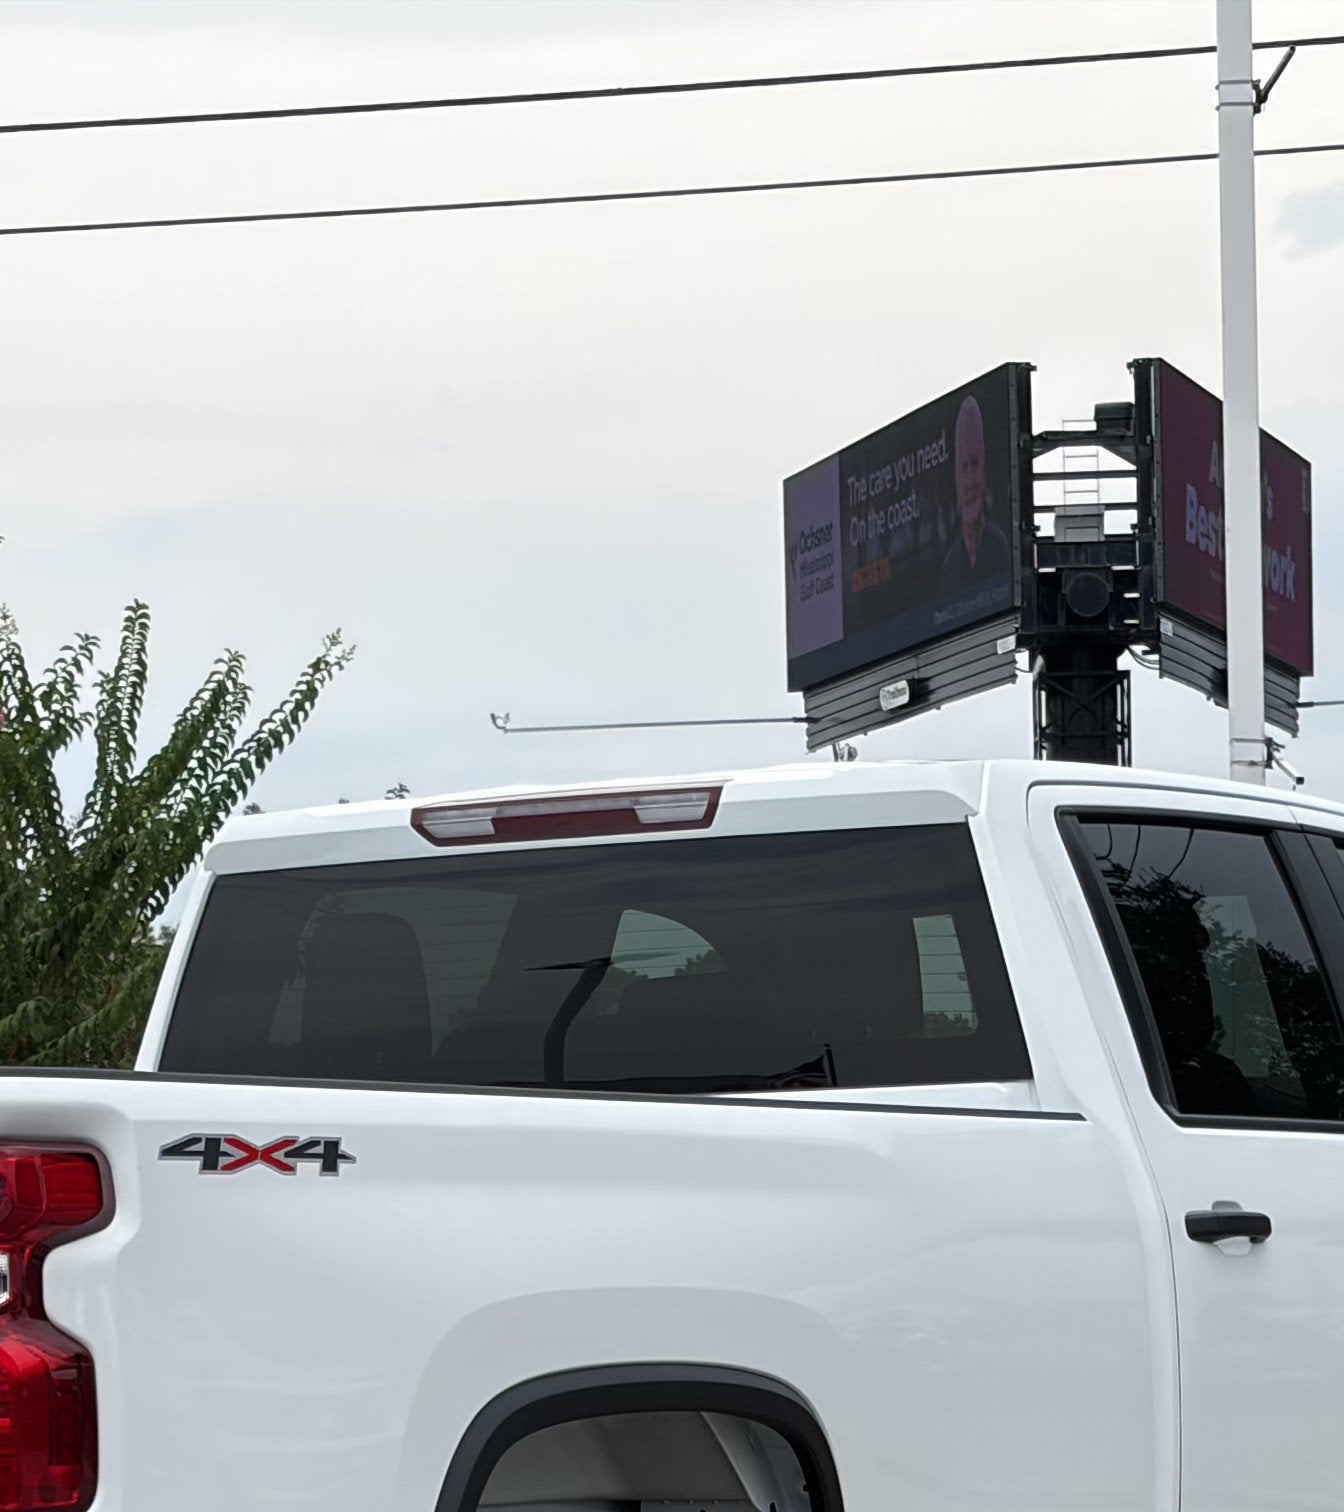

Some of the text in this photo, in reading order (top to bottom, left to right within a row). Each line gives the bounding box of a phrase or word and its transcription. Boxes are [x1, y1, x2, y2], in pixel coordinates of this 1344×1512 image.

[847, 428, 949, 507] The care you need.
[849, 488, 920, 547] On the coast.
[1185, 482, 1223, 561] Best
